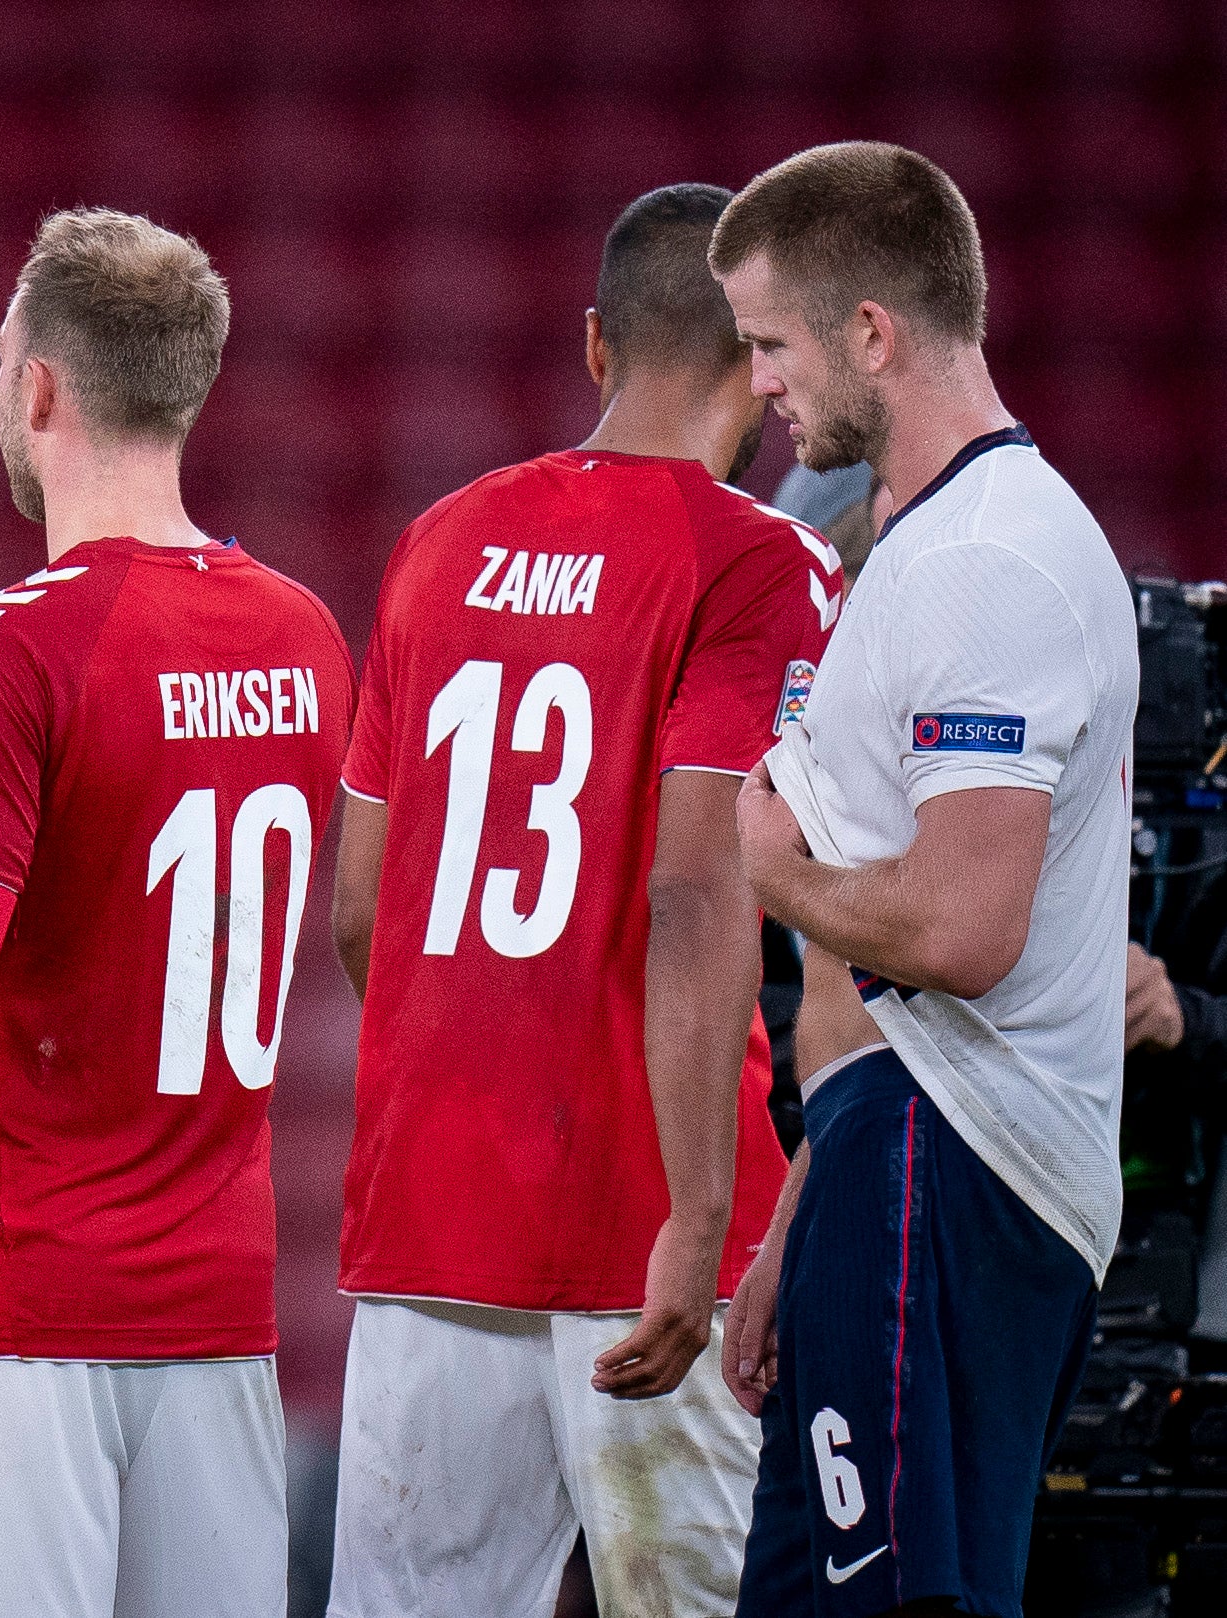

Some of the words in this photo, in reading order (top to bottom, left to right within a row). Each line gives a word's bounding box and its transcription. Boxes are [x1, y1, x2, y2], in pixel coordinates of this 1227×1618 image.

[464, 546, 605, 615] ZANKA
[157, 667, 319, 740] ERIKSEN
[942, 723, 1024, 742] RESPECT
[422, 660, 594, 959] 13
[145, 783, 313, 1096] 10
[810, 1407, 866, 1530] 6
